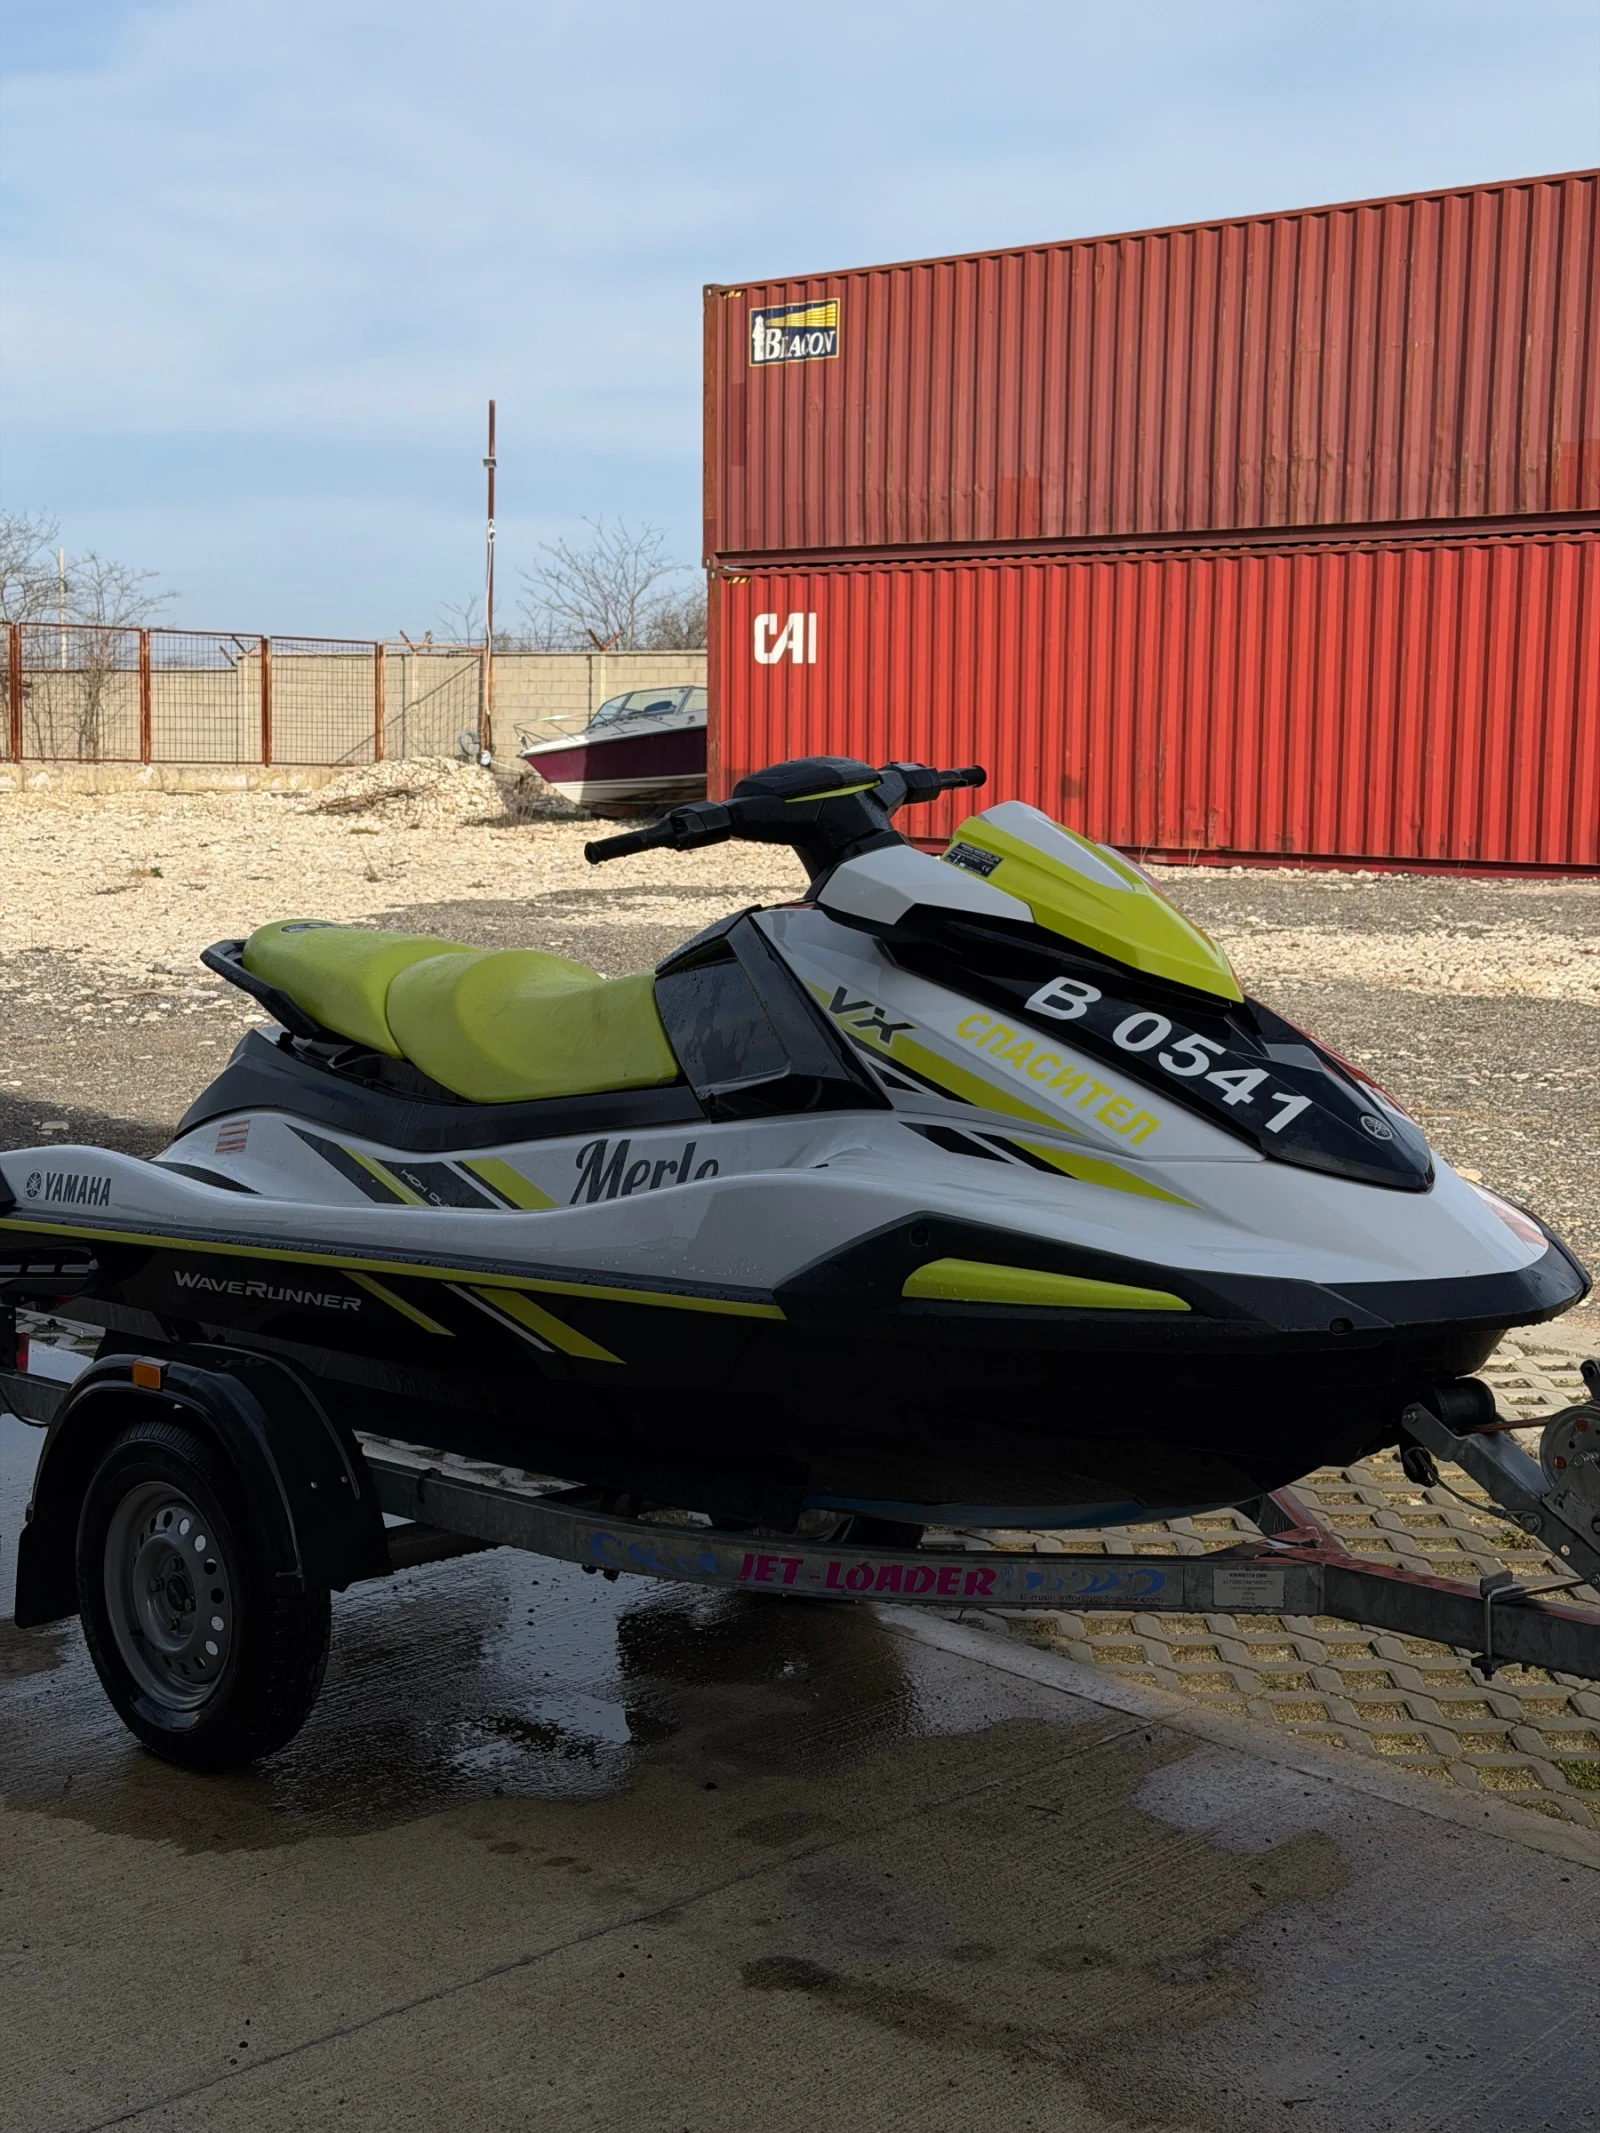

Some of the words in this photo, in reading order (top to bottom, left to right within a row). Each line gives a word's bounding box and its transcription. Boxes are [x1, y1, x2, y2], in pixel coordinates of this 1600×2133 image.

[764, 328, 836, 359] BEACON
[754, 612, 817, 664] CAI
[828, 986, 916, 1043] VX
[956, 1013, 1162, 1146] СПАСИТЕЛ
[1112, 1012, 1316, 1133] 0541
[45, 1171, 112, 1206] YAMAHA
[400, 1168, 429, 1193] HIGH
